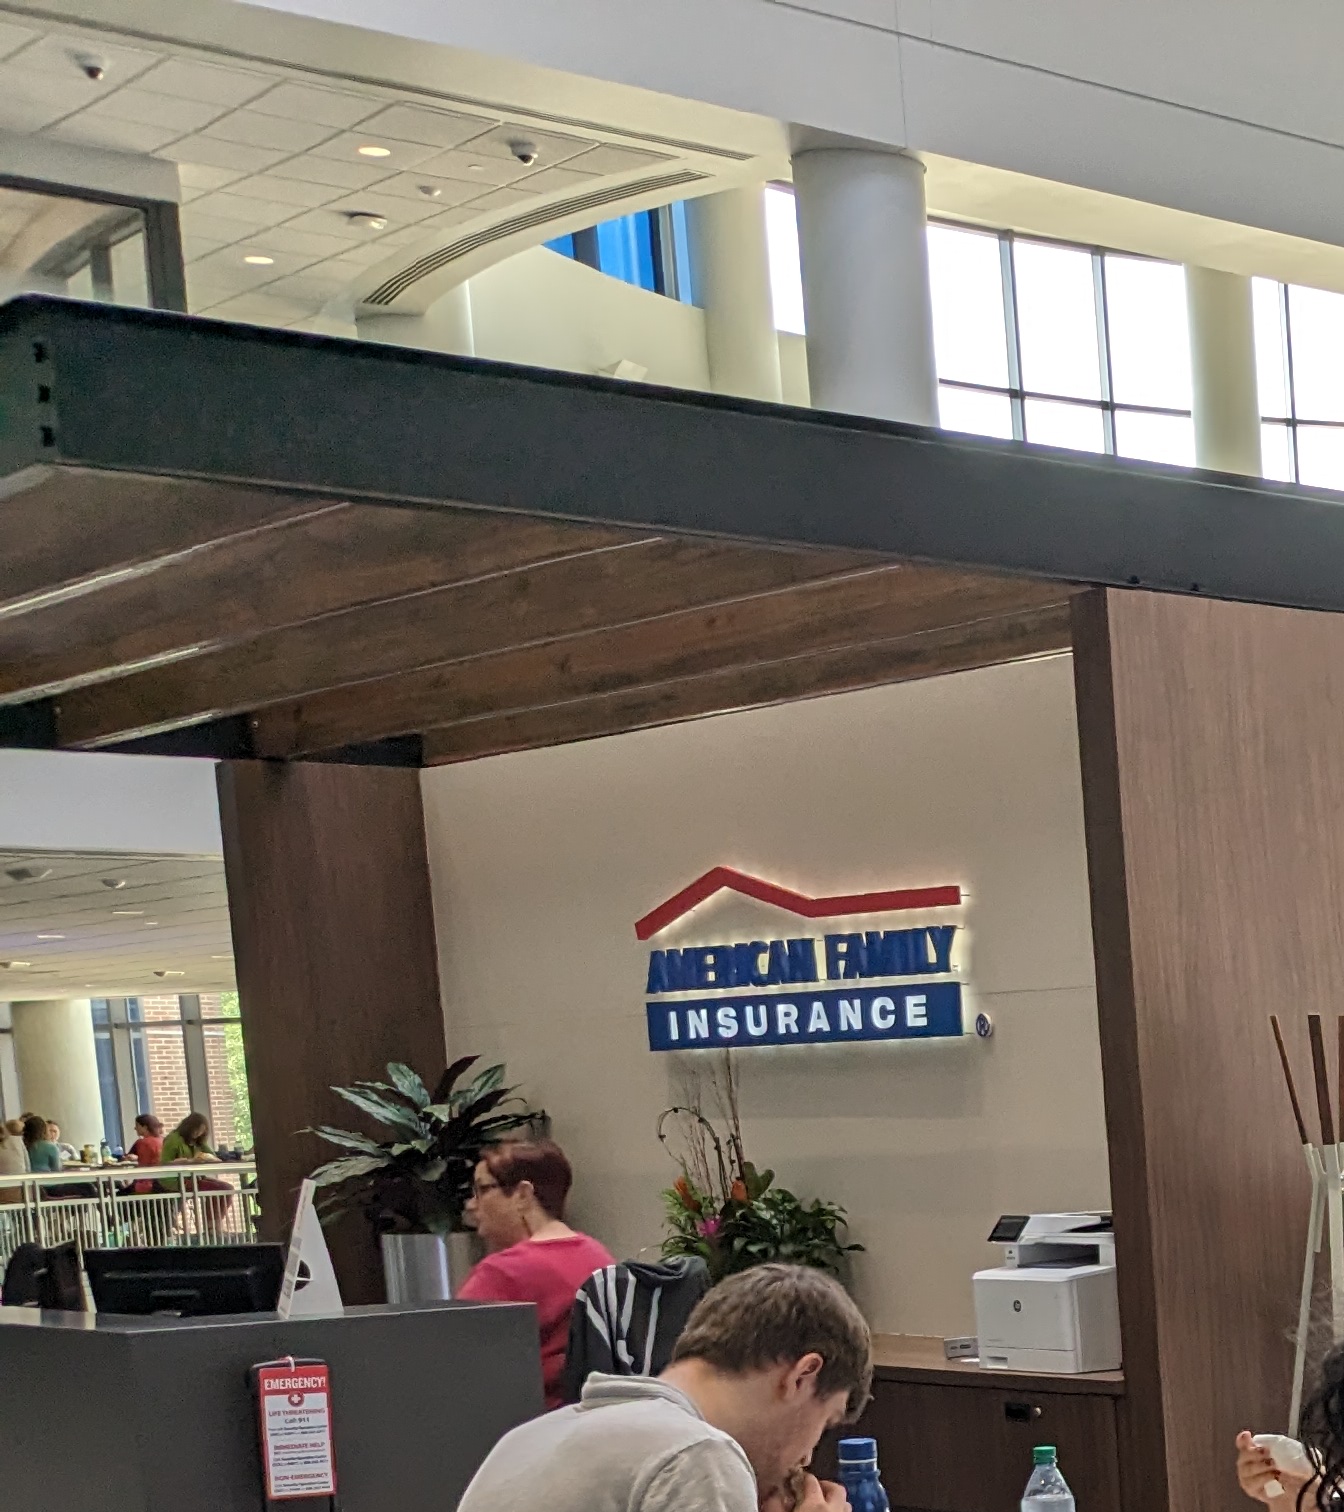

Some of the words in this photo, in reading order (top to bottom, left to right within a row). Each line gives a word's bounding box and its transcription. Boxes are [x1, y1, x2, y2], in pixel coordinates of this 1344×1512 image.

[646, 937, 819, 993] AMERICAN
[823, 924, 959, 981] FAMILY
[668, 994, 928, 1041] INSURANCE
[264, 1376, 326, 1391] EMERGENCY!
